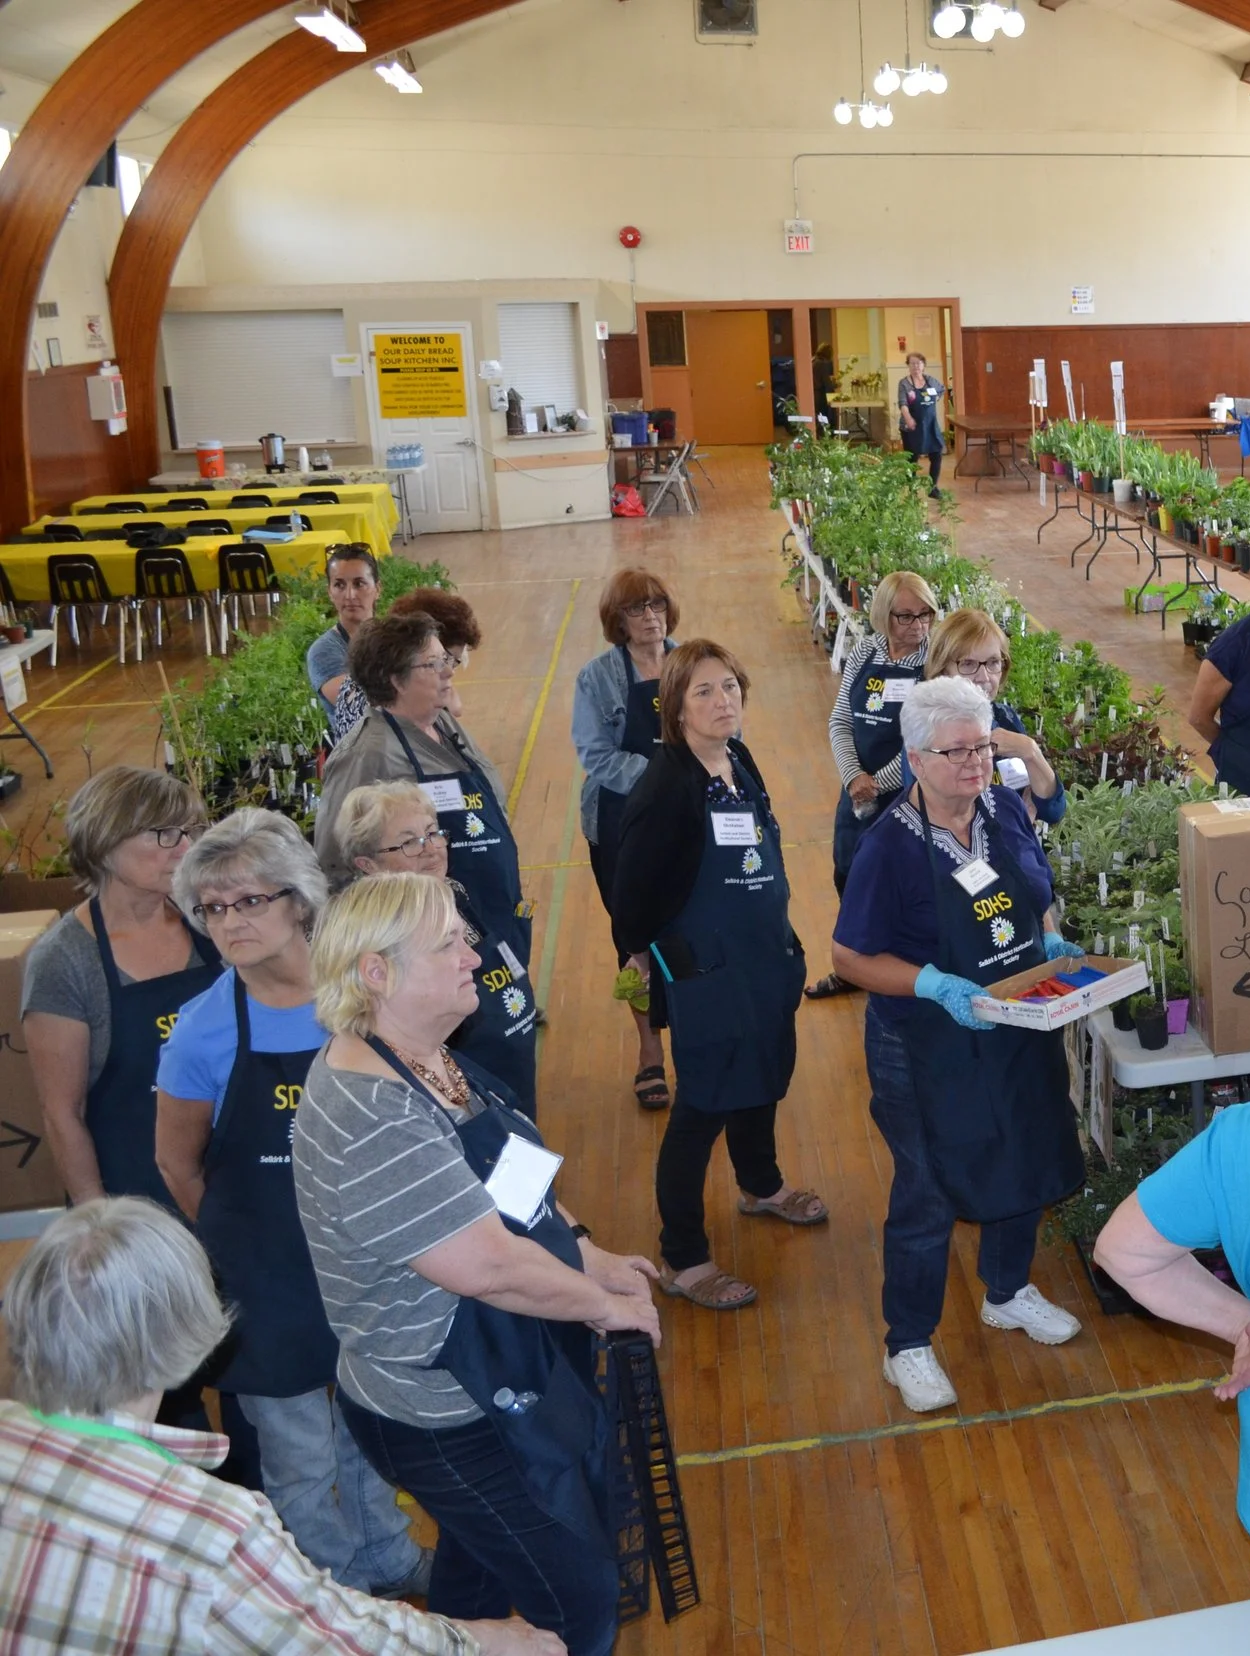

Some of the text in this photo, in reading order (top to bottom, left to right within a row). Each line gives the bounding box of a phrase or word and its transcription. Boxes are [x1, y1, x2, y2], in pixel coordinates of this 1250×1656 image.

[788, 236, 809, 250] EXIT
[434, 336, 445, 344] TO
[463, 793, 483, 810] DHS
[973, 891, 1013, 921] SDHS
[978, 957, 994, 968] Selkirk
[1003, 954, 1020, 966] Society
[260, 1155, 291, 1163] Selkirk &
